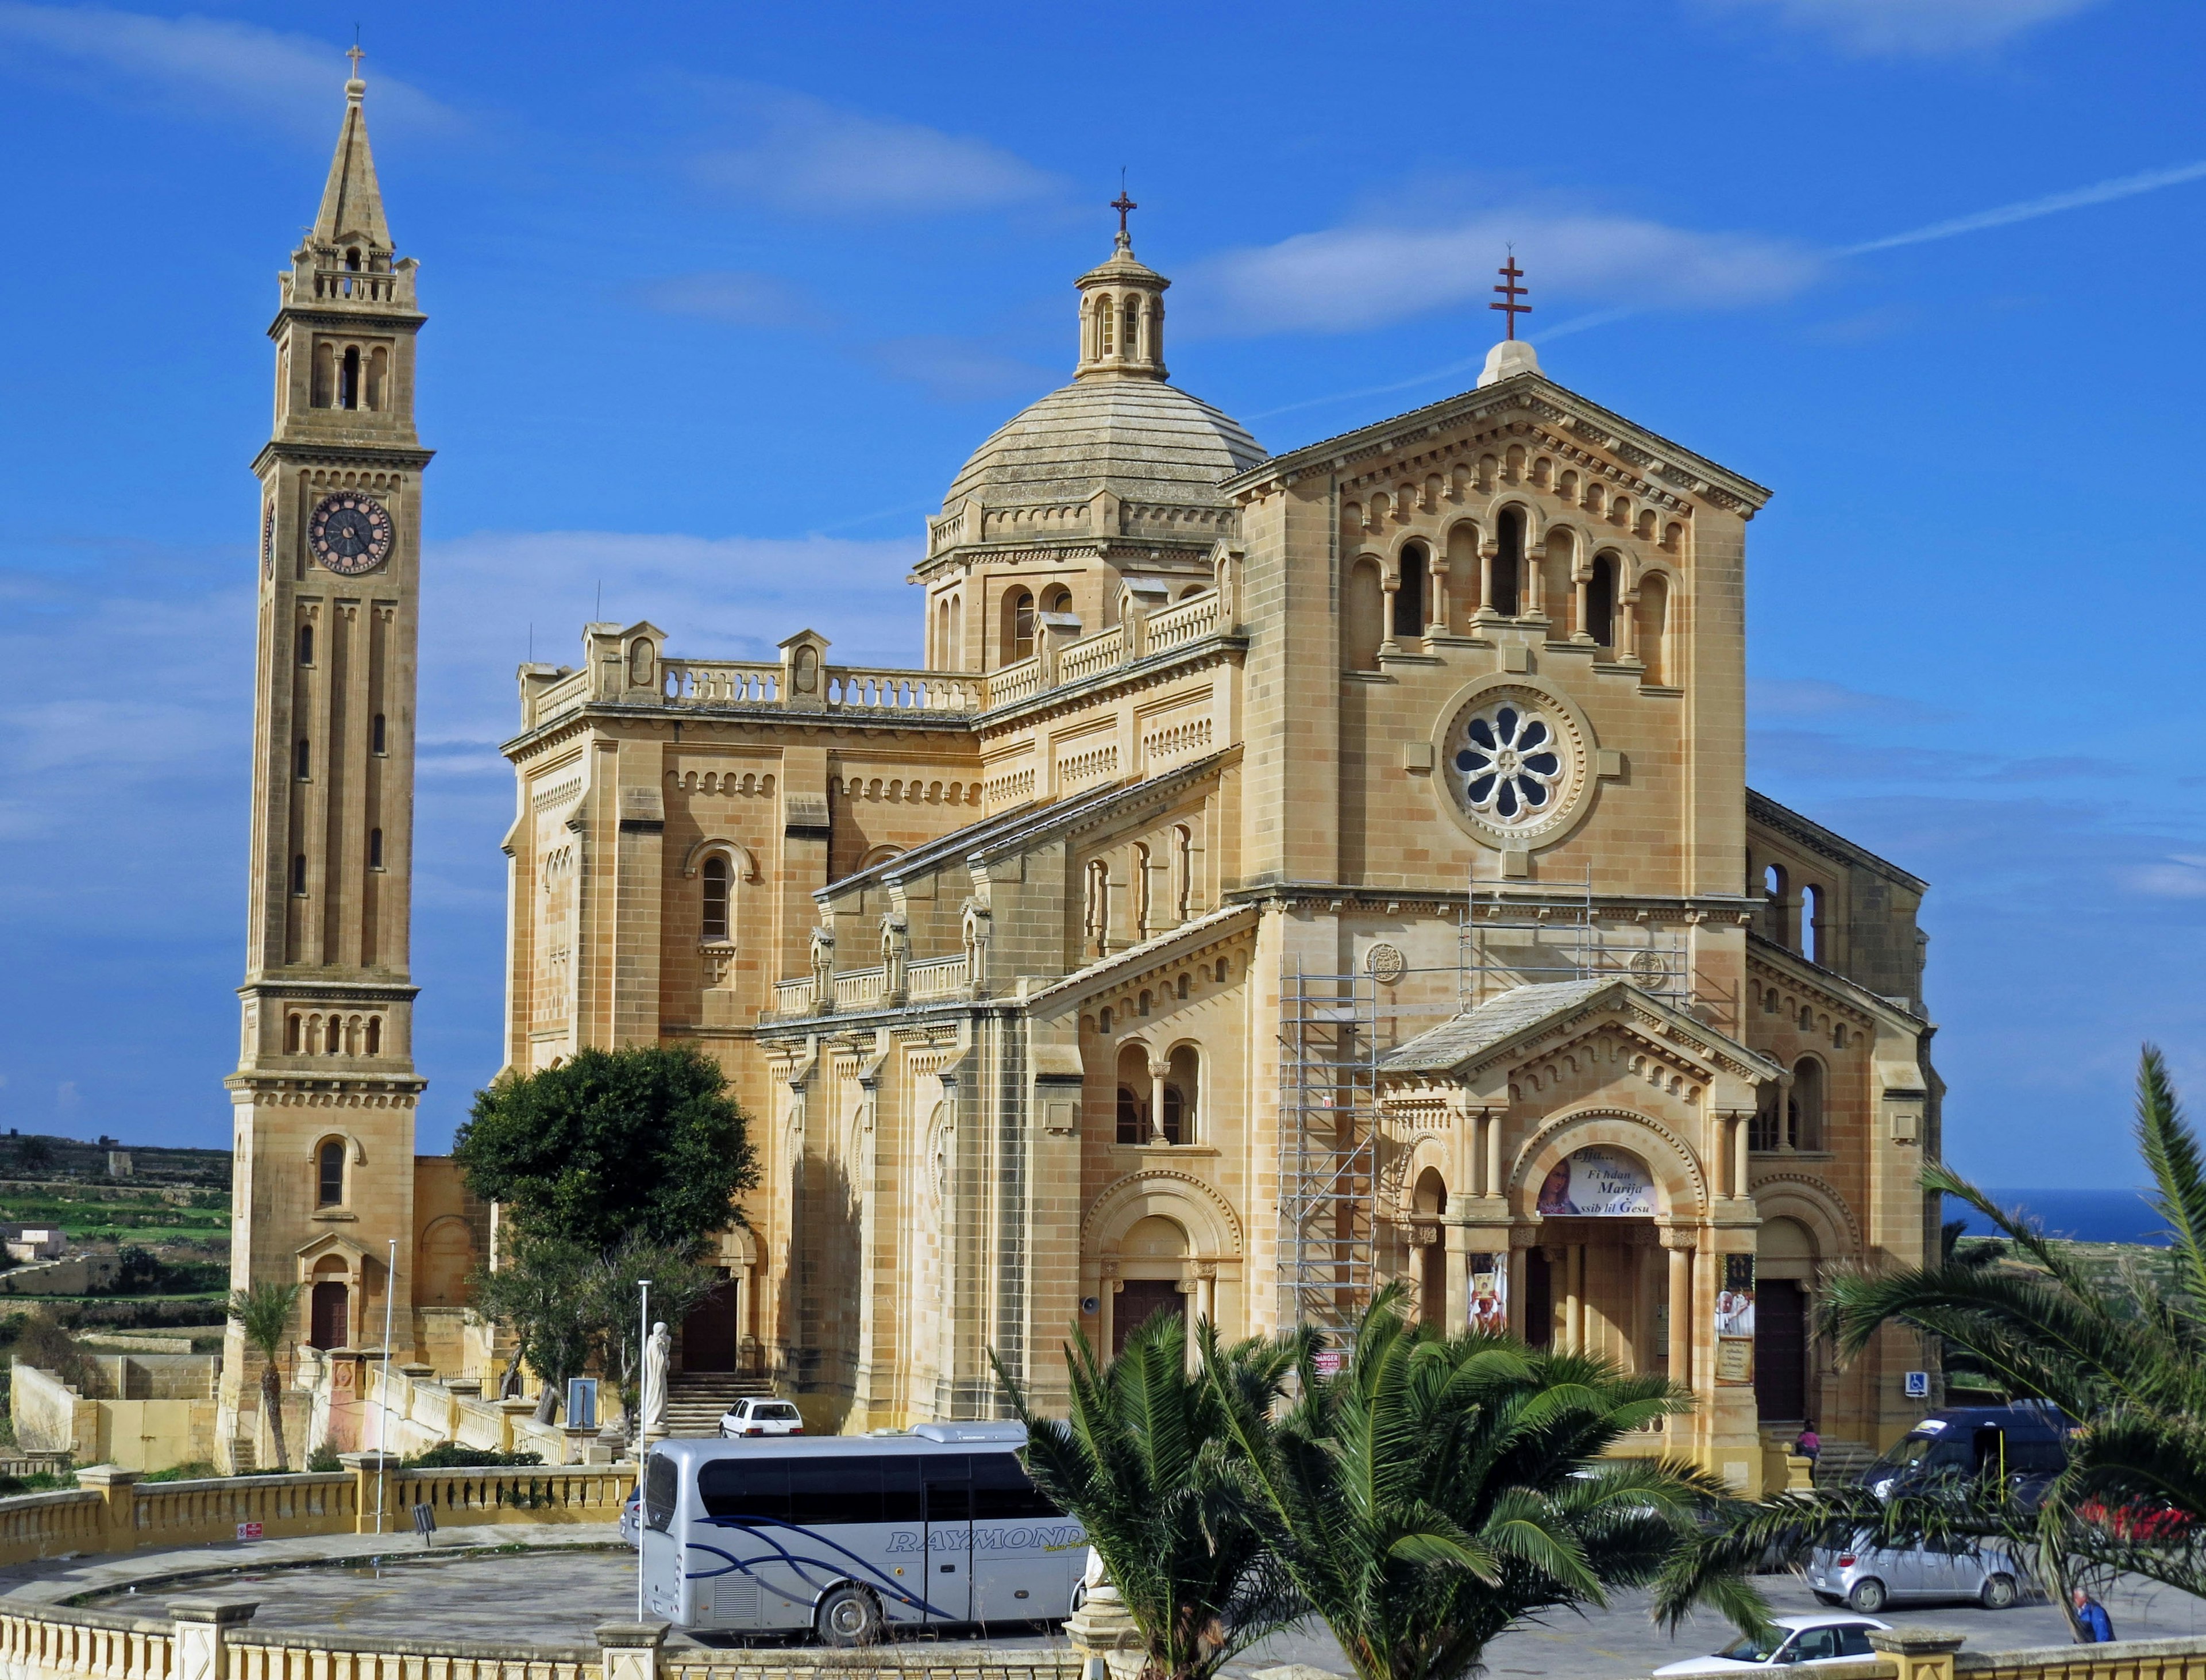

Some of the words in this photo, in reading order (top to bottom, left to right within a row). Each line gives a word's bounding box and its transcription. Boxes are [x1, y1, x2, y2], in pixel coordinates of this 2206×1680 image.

[1588, 1170, 1600, 1179] Fi
[1597, 1182, 1642, 1196] Marija
[1580, 1204, 1601, 1213] ssib
[1605, 1204, 1615, 1212] lil
[885, 1526, 1087, 1552] RAYMOND
